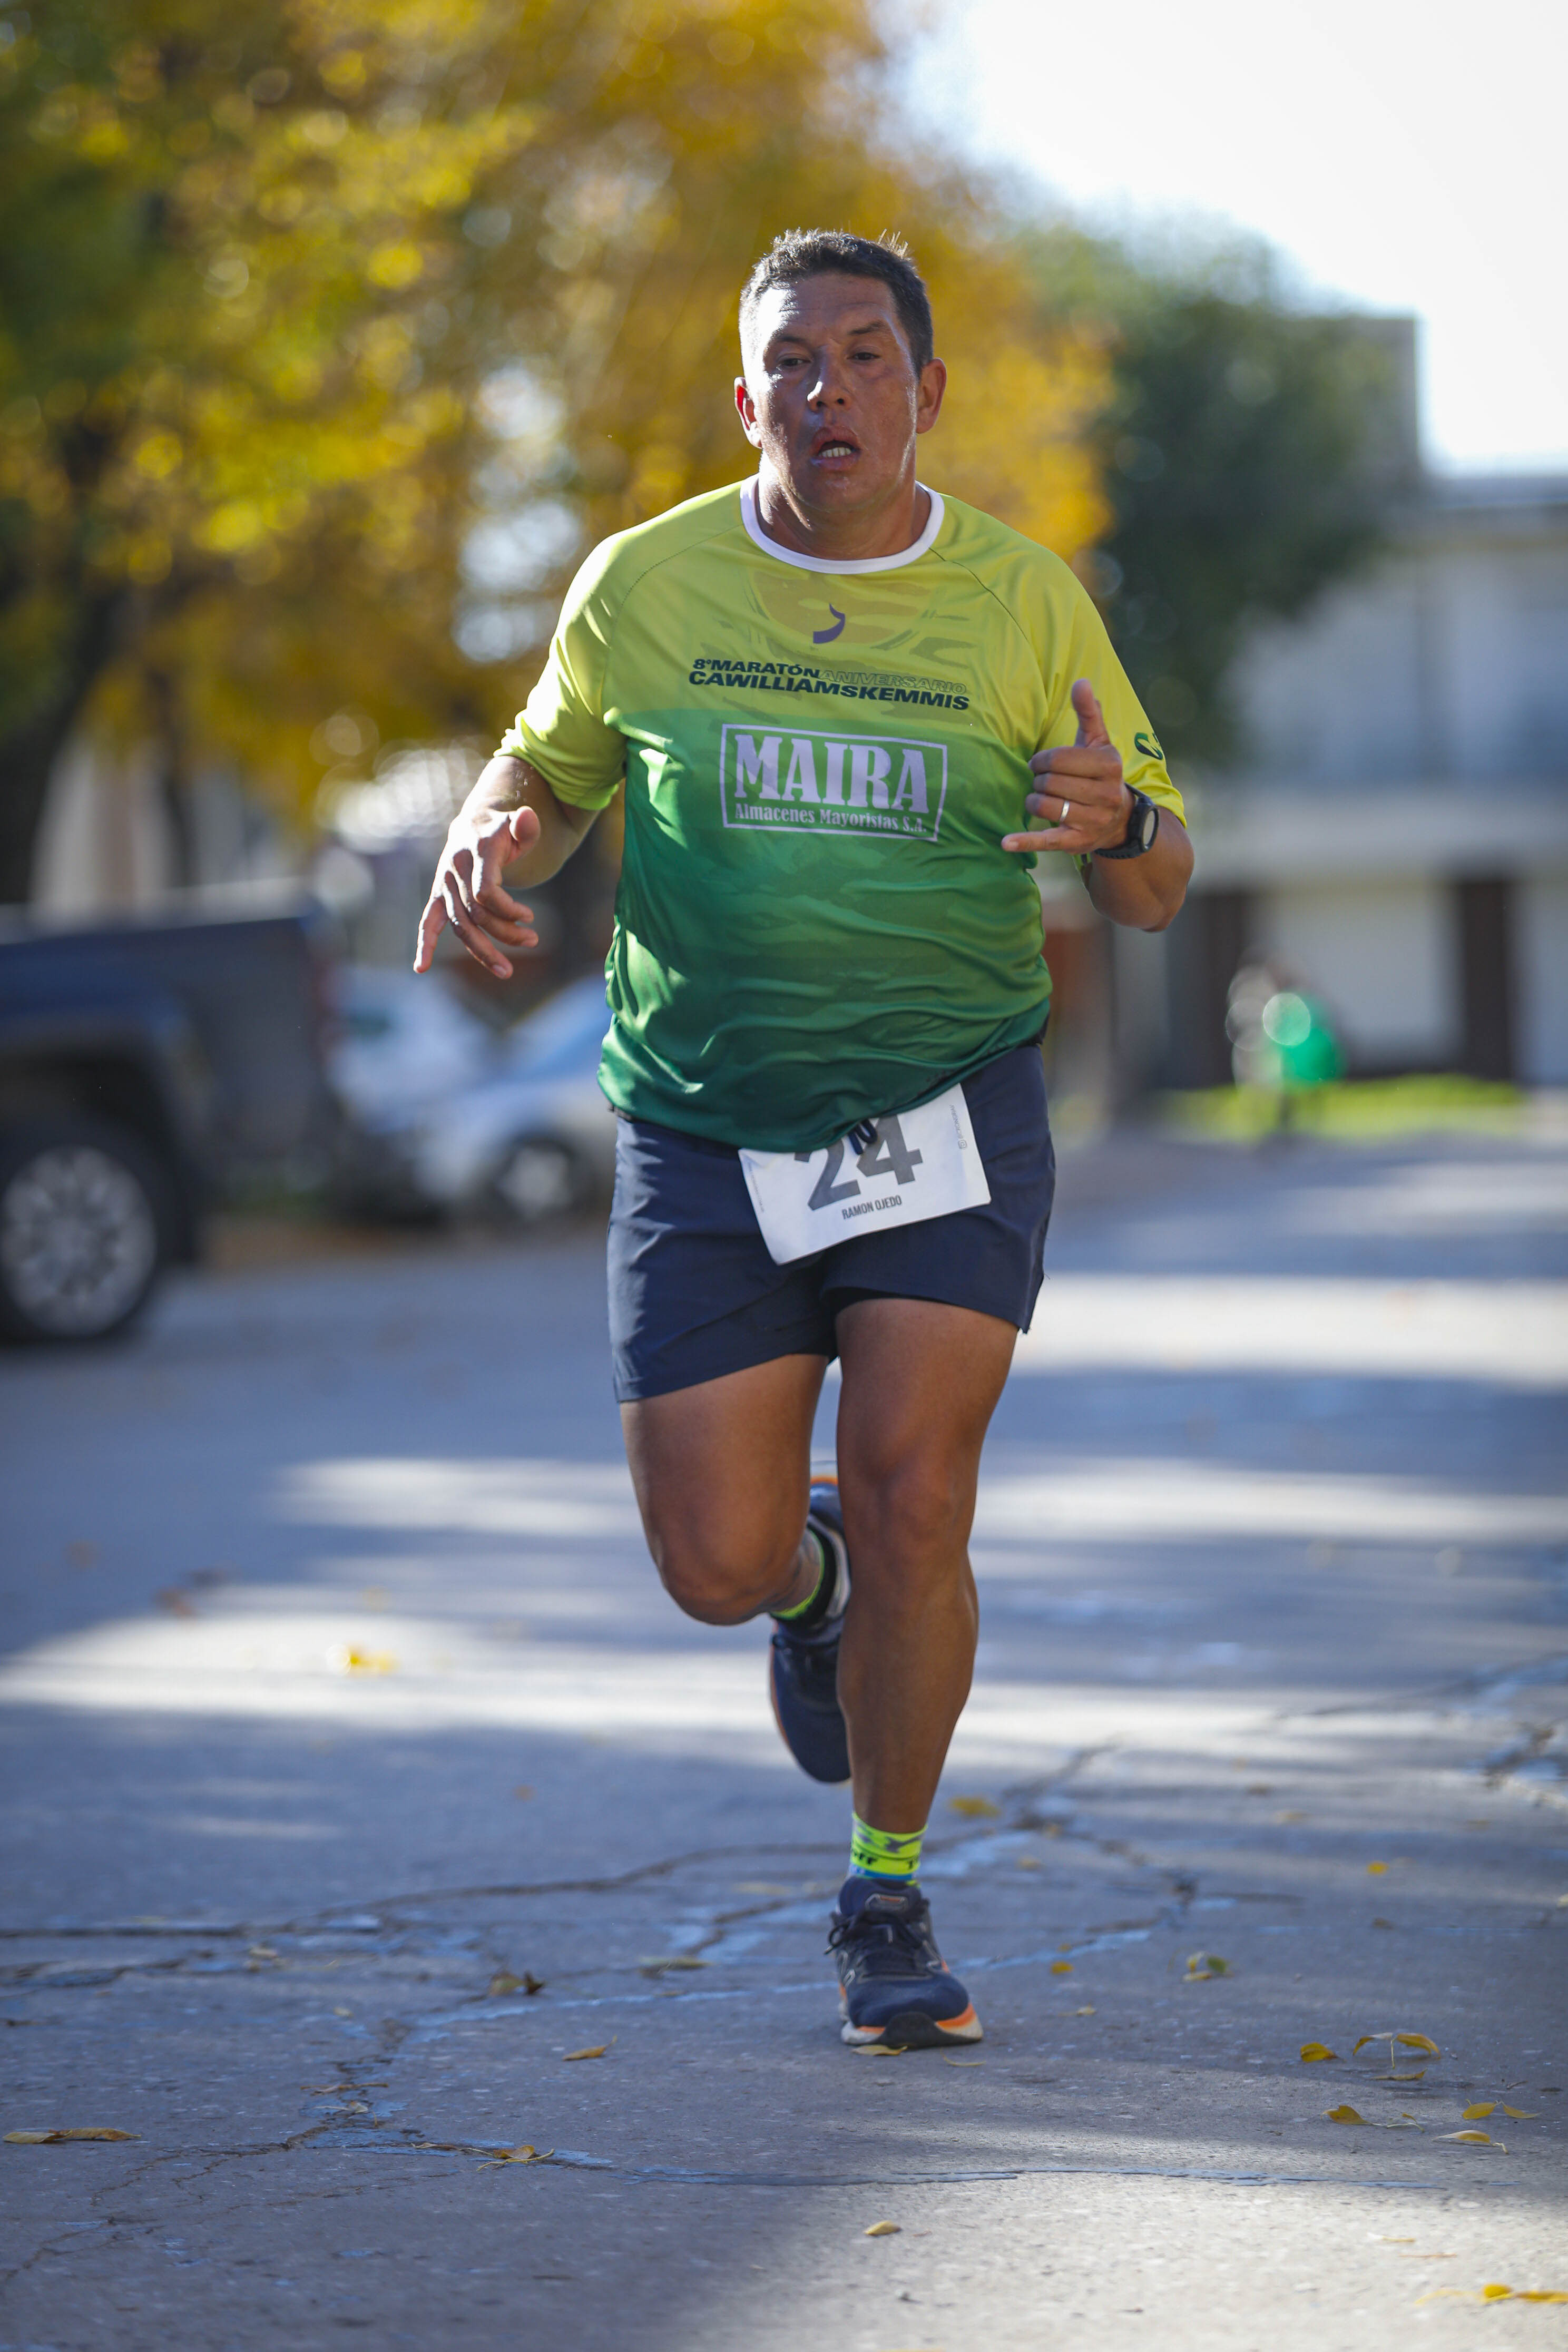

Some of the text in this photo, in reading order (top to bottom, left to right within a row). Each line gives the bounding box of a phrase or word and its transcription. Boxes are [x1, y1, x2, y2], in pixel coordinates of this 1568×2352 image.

[689, 670, 970, 710] CAWILLIAMSKEMMIS
[819, 670, 967, 694] ANIVERSARIO
[734, 734, 929, 814] MAIRA
[735, 803, 927, 832] Almacenes Mayoristas S.A.
[794, 1115, 923, 1211] 24
[841, 1194, 903, 1220] RAMON OJEDO
